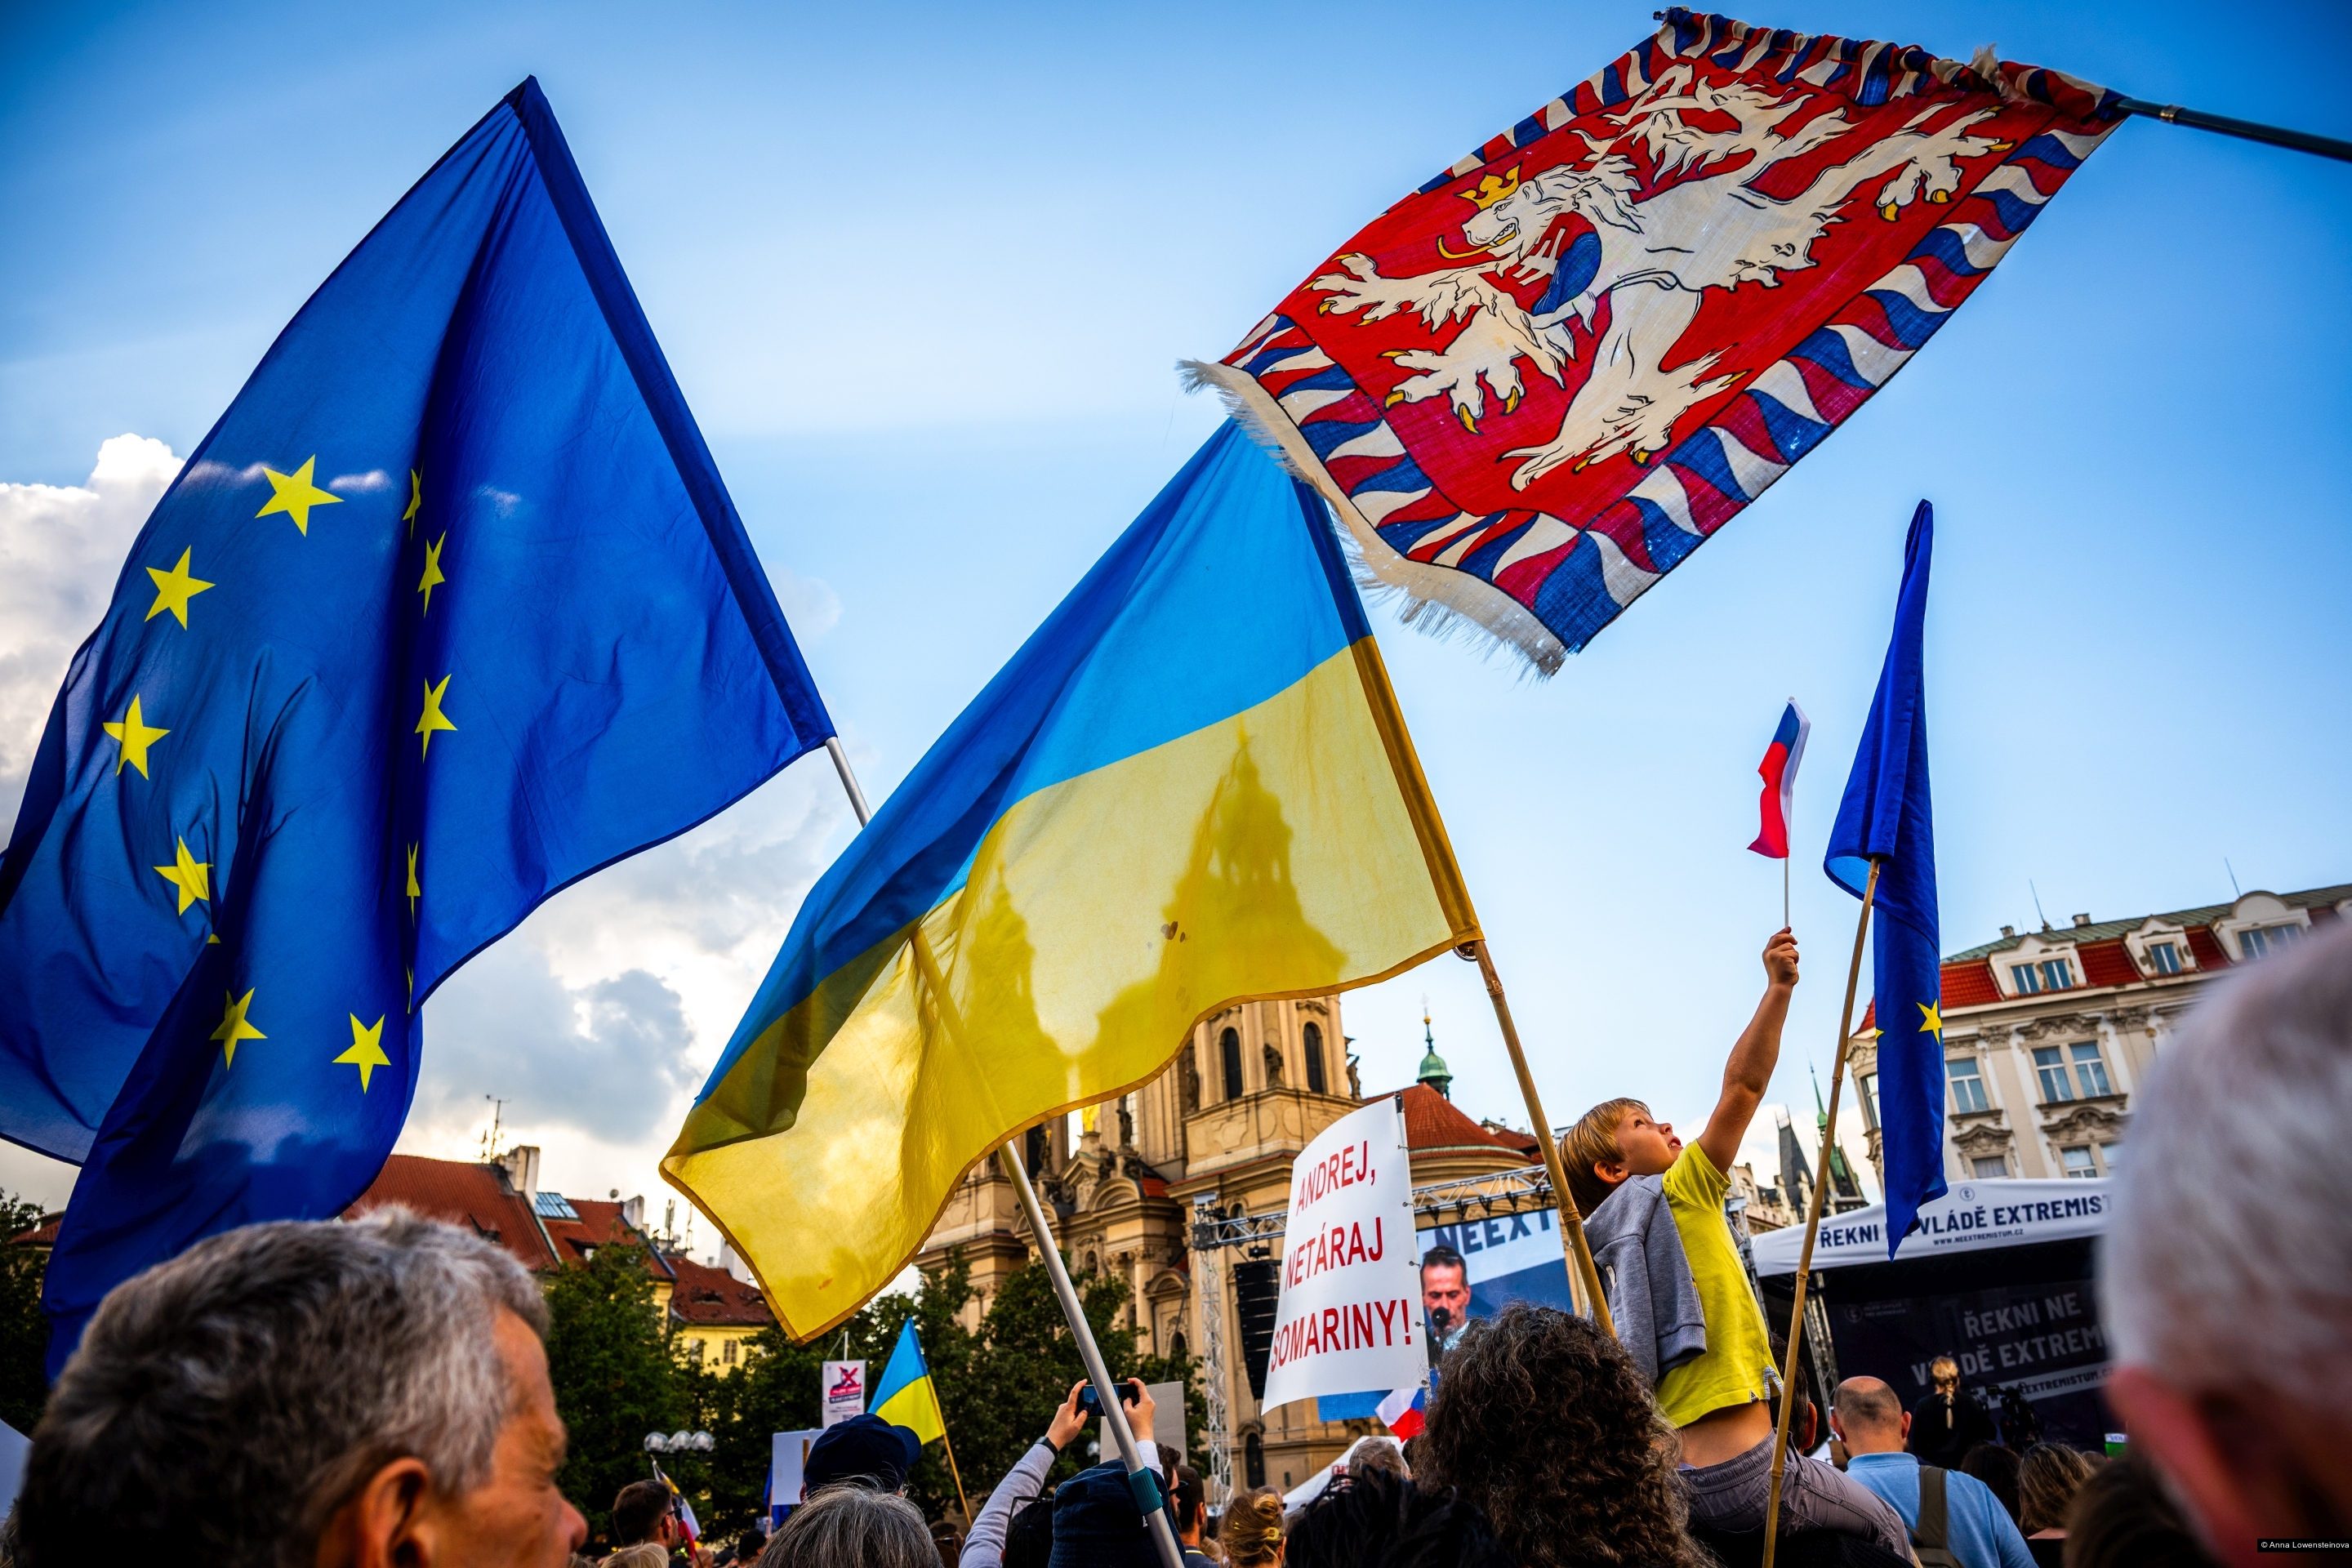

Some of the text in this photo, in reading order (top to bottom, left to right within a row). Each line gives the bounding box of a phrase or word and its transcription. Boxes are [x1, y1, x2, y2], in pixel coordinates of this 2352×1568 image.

[1295, 1140, 1375, 1217] ANDREJ,
[1820, 1224, 1879, 1249] ŘEKNI
[1919, 1205, 1988, 1236] VLÁDĚ
[1933, 1228, 2024, 1245] WWW.NEEXTREMISTUM.CZ
[1285, 1216, 1383, 1293] NETÁRAJ
[1270, 1298, 1411, 1373] SOMARINY!
[1963, 1292, 2082, 1339] ŘEKNI NE
[1911, 1343, 1994, 1386] VDĚ
